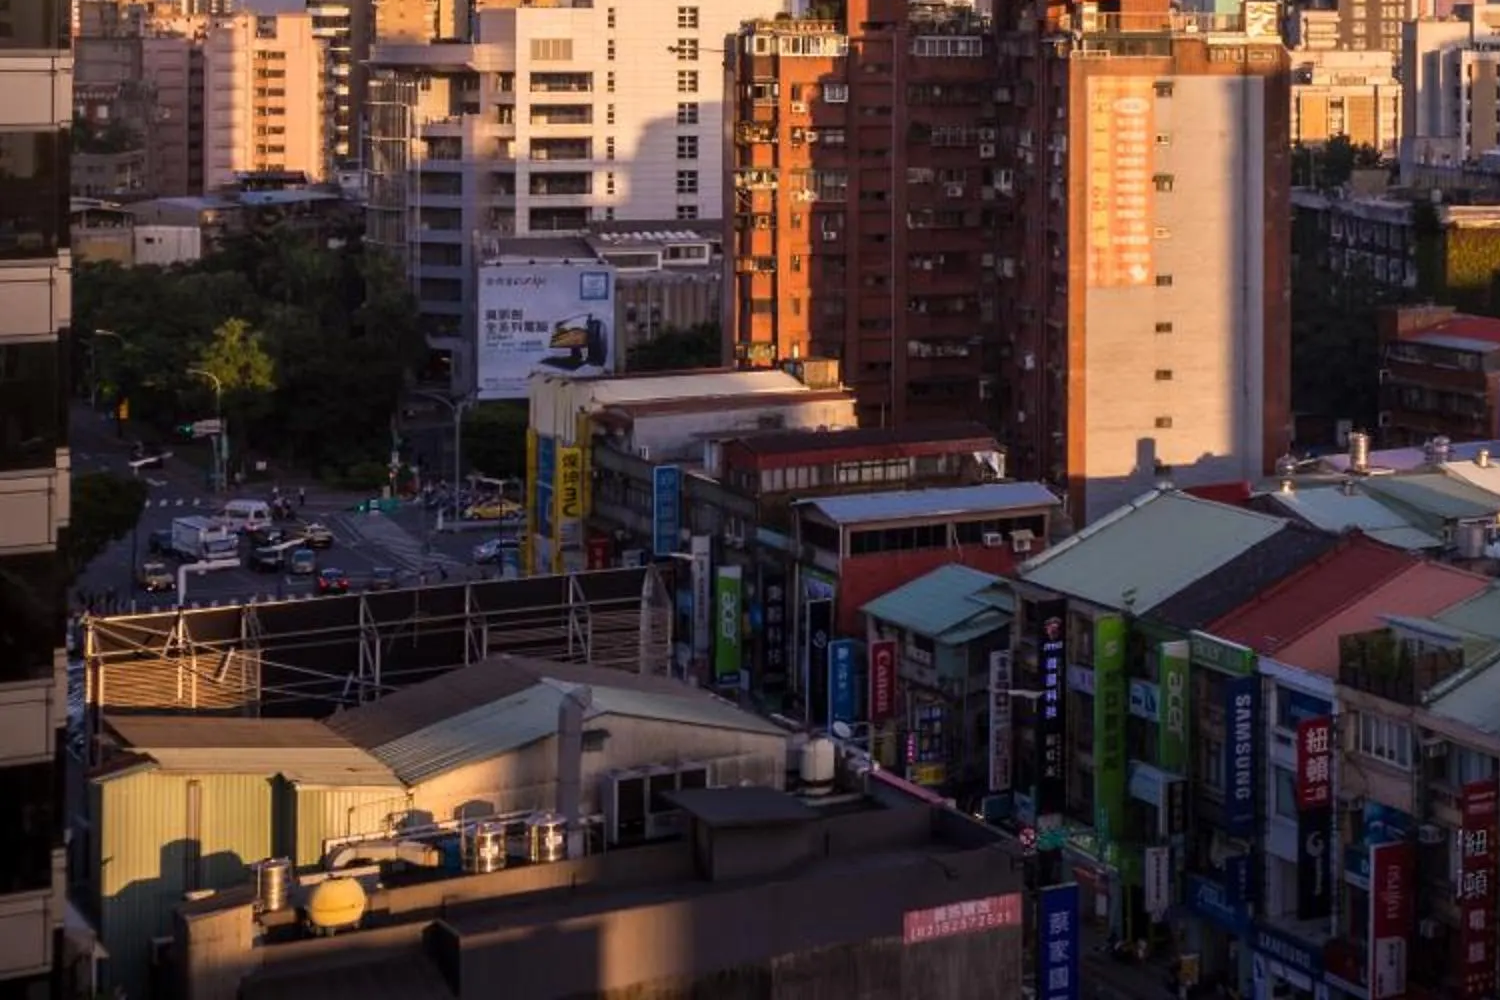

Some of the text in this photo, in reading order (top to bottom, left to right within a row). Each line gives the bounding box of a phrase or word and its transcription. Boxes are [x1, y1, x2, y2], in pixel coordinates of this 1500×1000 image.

[721, 592, 737, 645] acer
[876, 649, 889, 714] Canon
[1167, 671, 1184, 742] acer
[1235, 693, 1251, 801] SAMSUNG
[1047, 910, 1070, 1000] 蔡家國
